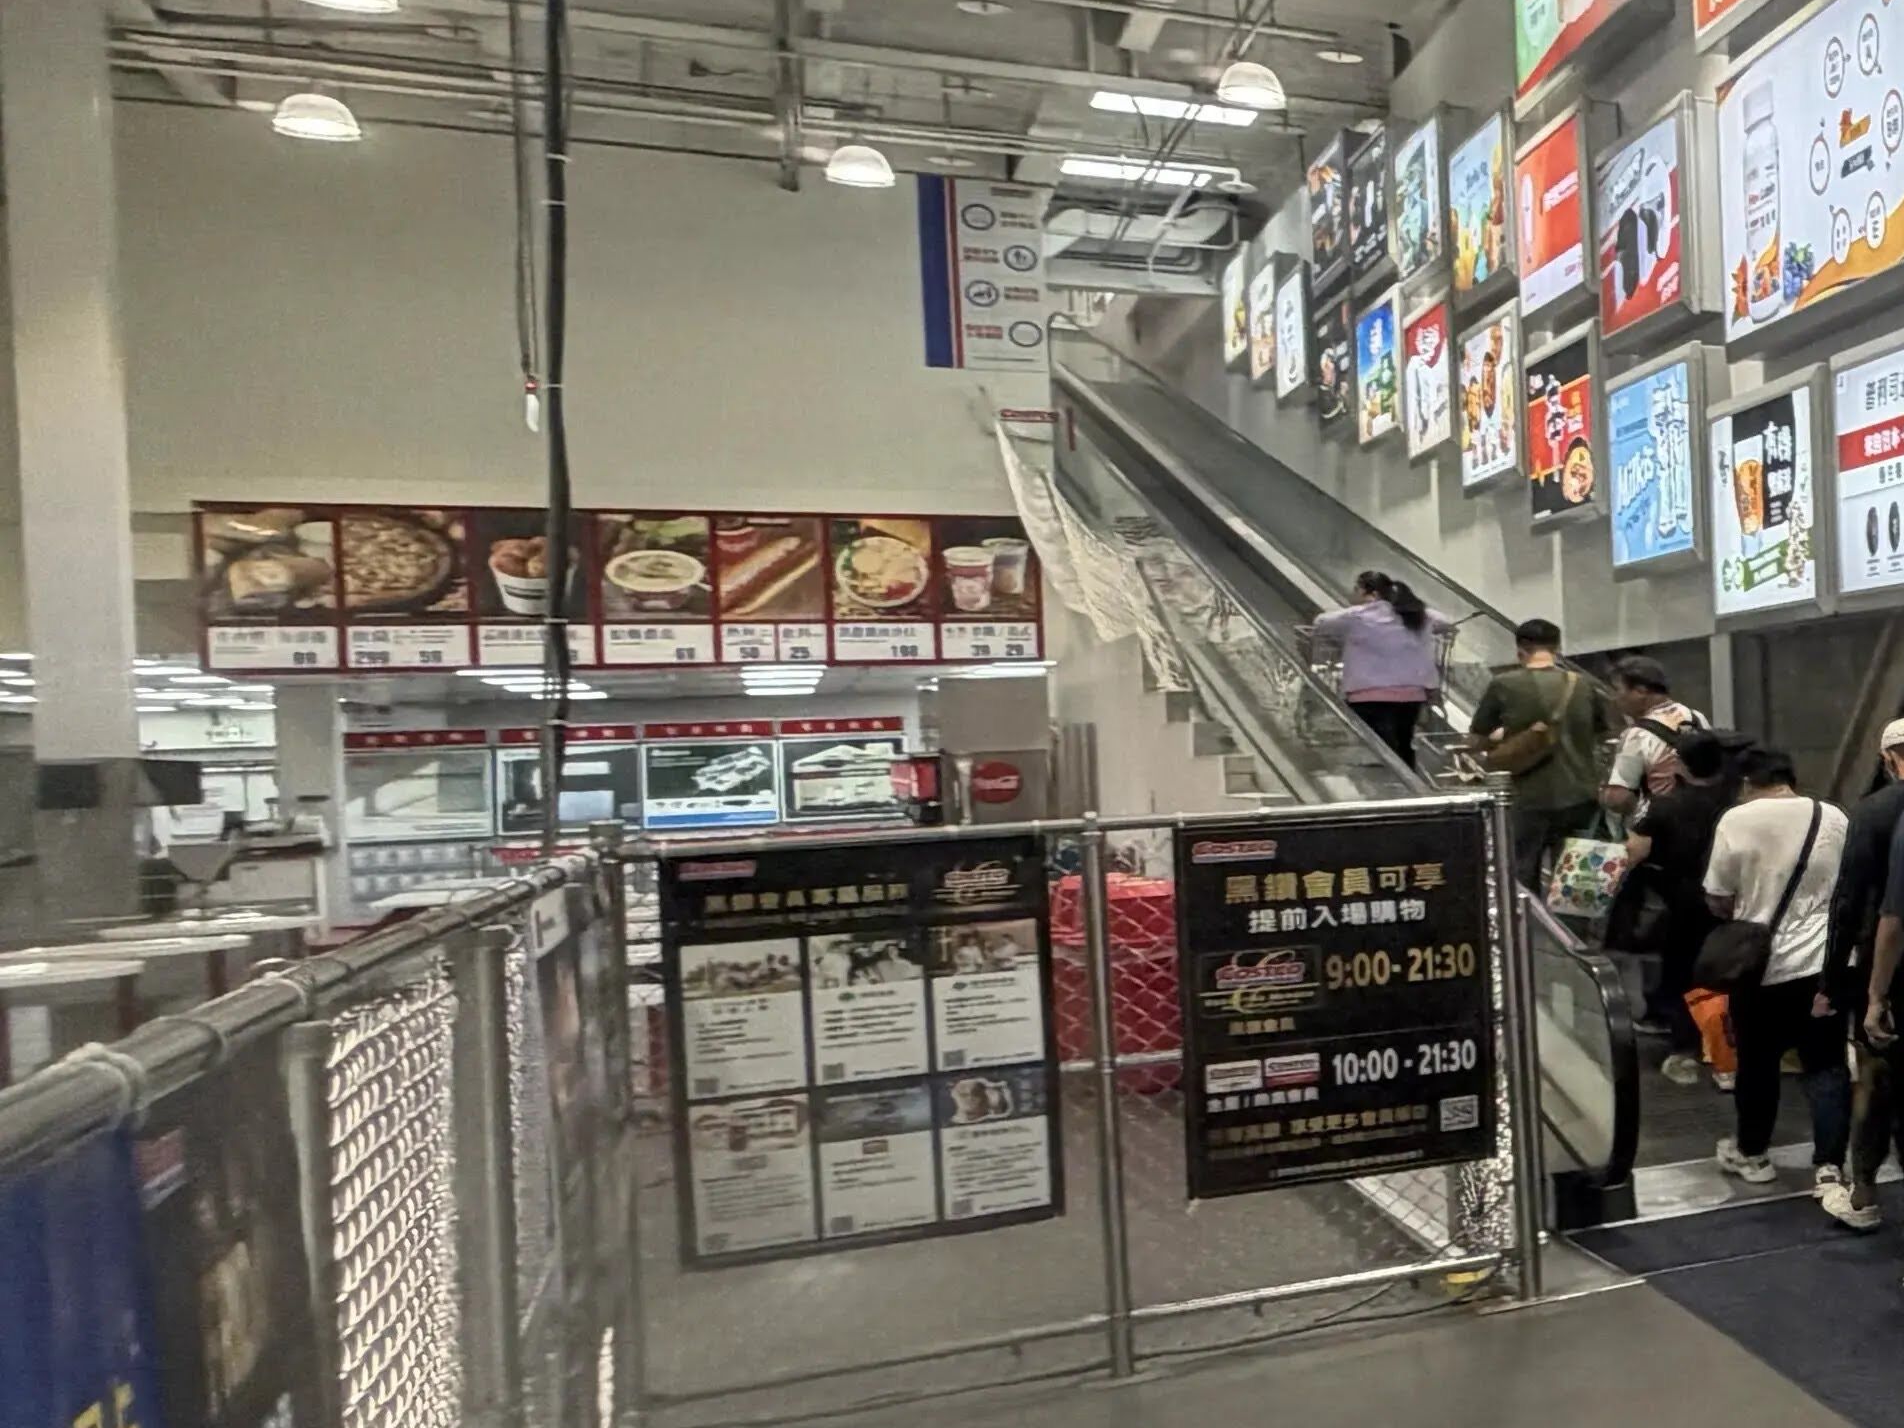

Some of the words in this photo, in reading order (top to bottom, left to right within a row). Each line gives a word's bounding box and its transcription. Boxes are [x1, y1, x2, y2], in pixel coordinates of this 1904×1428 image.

[1248, 899, 1426, 934] 提前入場購物
[1407, 942, 1475, 982] 21:30
[1332, 1047, 1398, 1086] 10:00
[1418, 1038, 1477, 1076] 21:30
